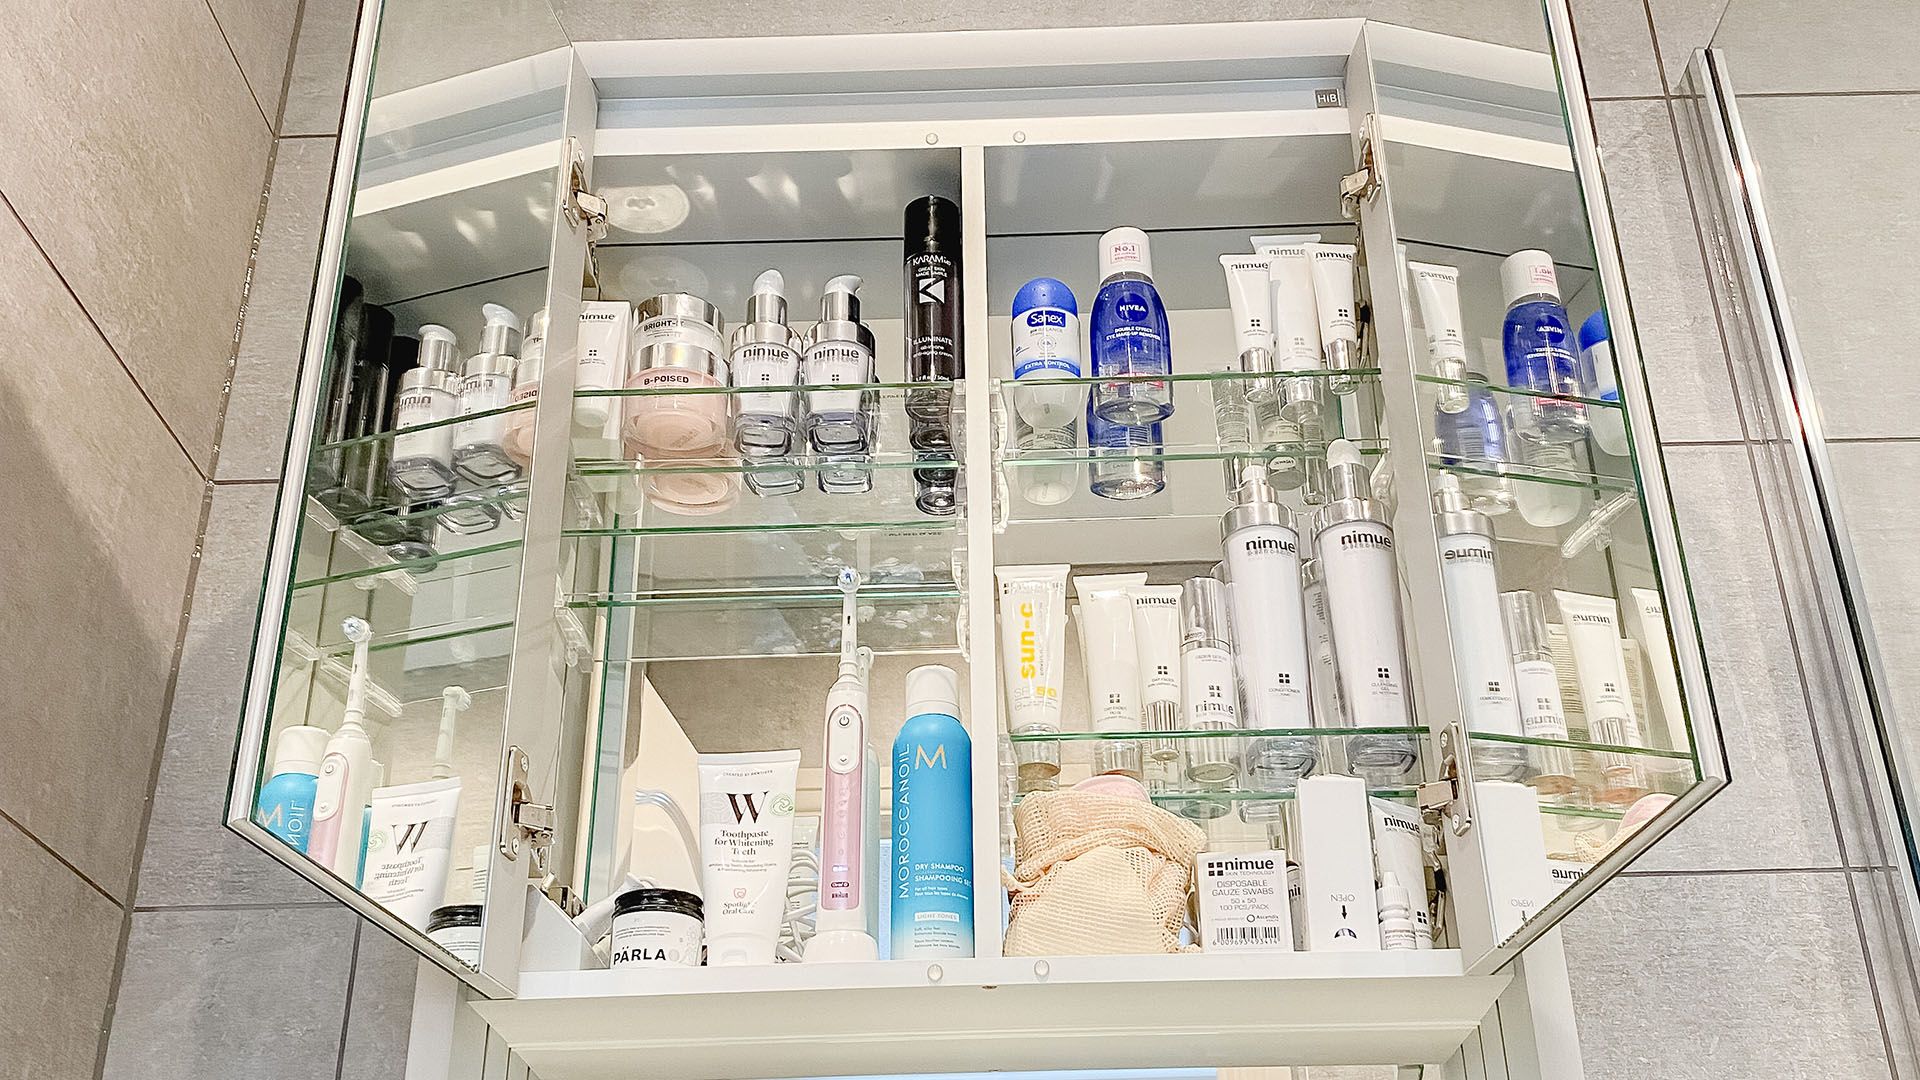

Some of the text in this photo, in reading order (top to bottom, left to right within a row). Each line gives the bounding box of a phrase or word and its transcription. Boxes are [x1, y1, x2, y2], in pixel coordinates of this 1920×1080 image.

[1315, 251, 1352, 261] nimue
[1230, 261, 1269, 270] nimue
[1119, 304, 1147, 313] NIVEA
[1030, 312, 1063, 325] Sanex
[743, 345, 790, 360] nimue
[814, 344, 860, 360] nimue
[643, 375, 690, 386] B-POISED
[1245, 536, 1297, 553] nimue
[1341, 530, 1393, 548] nimue
[1136, 595, 1177, 606] nimue
[1019, 601, 1037, 680] sun-c
[1195, 700, 1234, 715] nimue
[915, 743, 948, 770] M
[726, 790, 770, 825] W
[898, 743, 910, 900] MOROCCANOIL
[1383, 815, 1421, 834] nimue
[721, 829, 769, 840] Toothpaste
[714, 837, 774, 848] for Whitening
[914, 862, 965, 873] DRY SHAMPOO
[1225, 857, 1274, 870] nimue
[914, 874, 963, 884] SHAMPOOING
[1216, 879, 1268, 888] DISPOSABLE
[1211, 887, 1274, 897] GAUZE SWABS
[723, 901, 758, 910] Spotlig
[613, 945, 667, 966] PÄRLA
